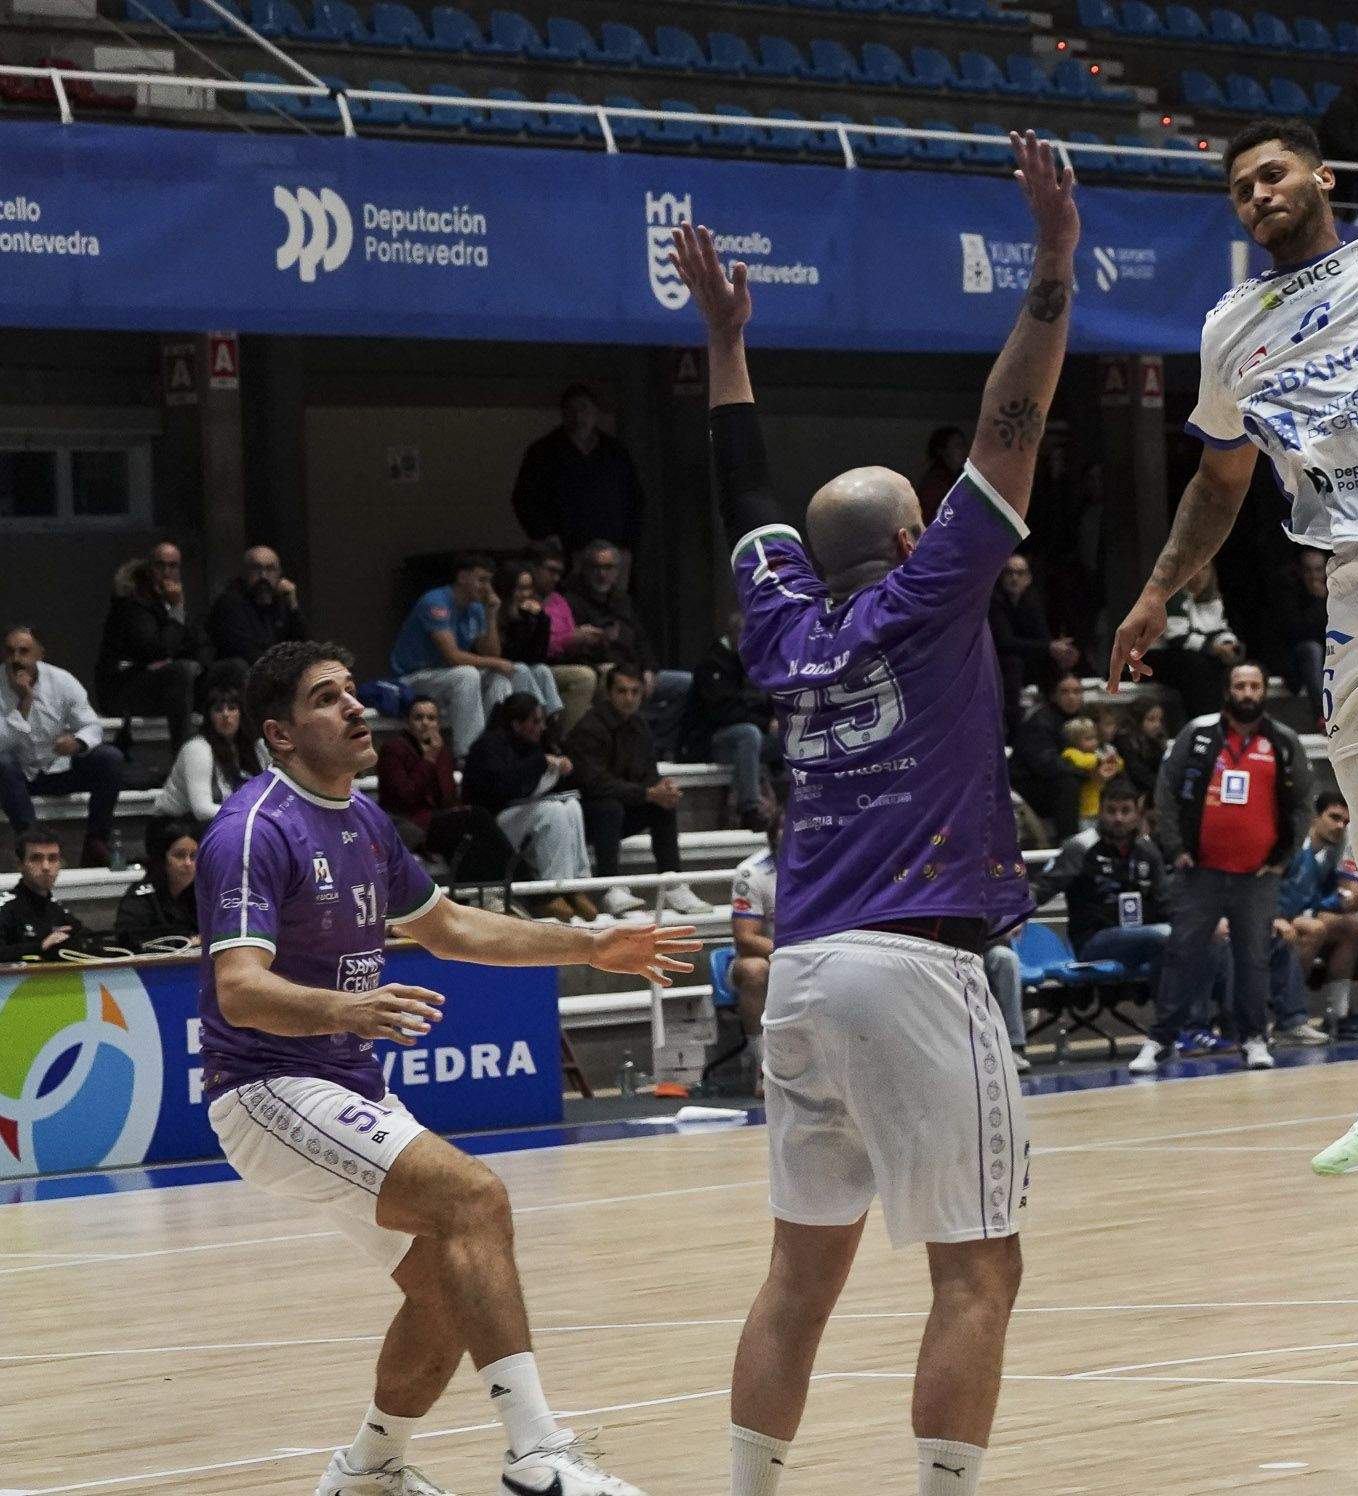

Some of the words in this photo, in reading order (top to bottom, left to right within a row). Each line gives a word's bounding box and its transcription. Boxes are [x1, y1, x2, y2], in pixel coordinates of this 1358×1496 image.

[364, 203, 487, 238] Deputación
[365, 236, 488, 267] Pontevedra
[710, 228, 772, 255] oncello
[728, 258, 820, 285] Pntevedra
[351, 882, 378, 928] 51
